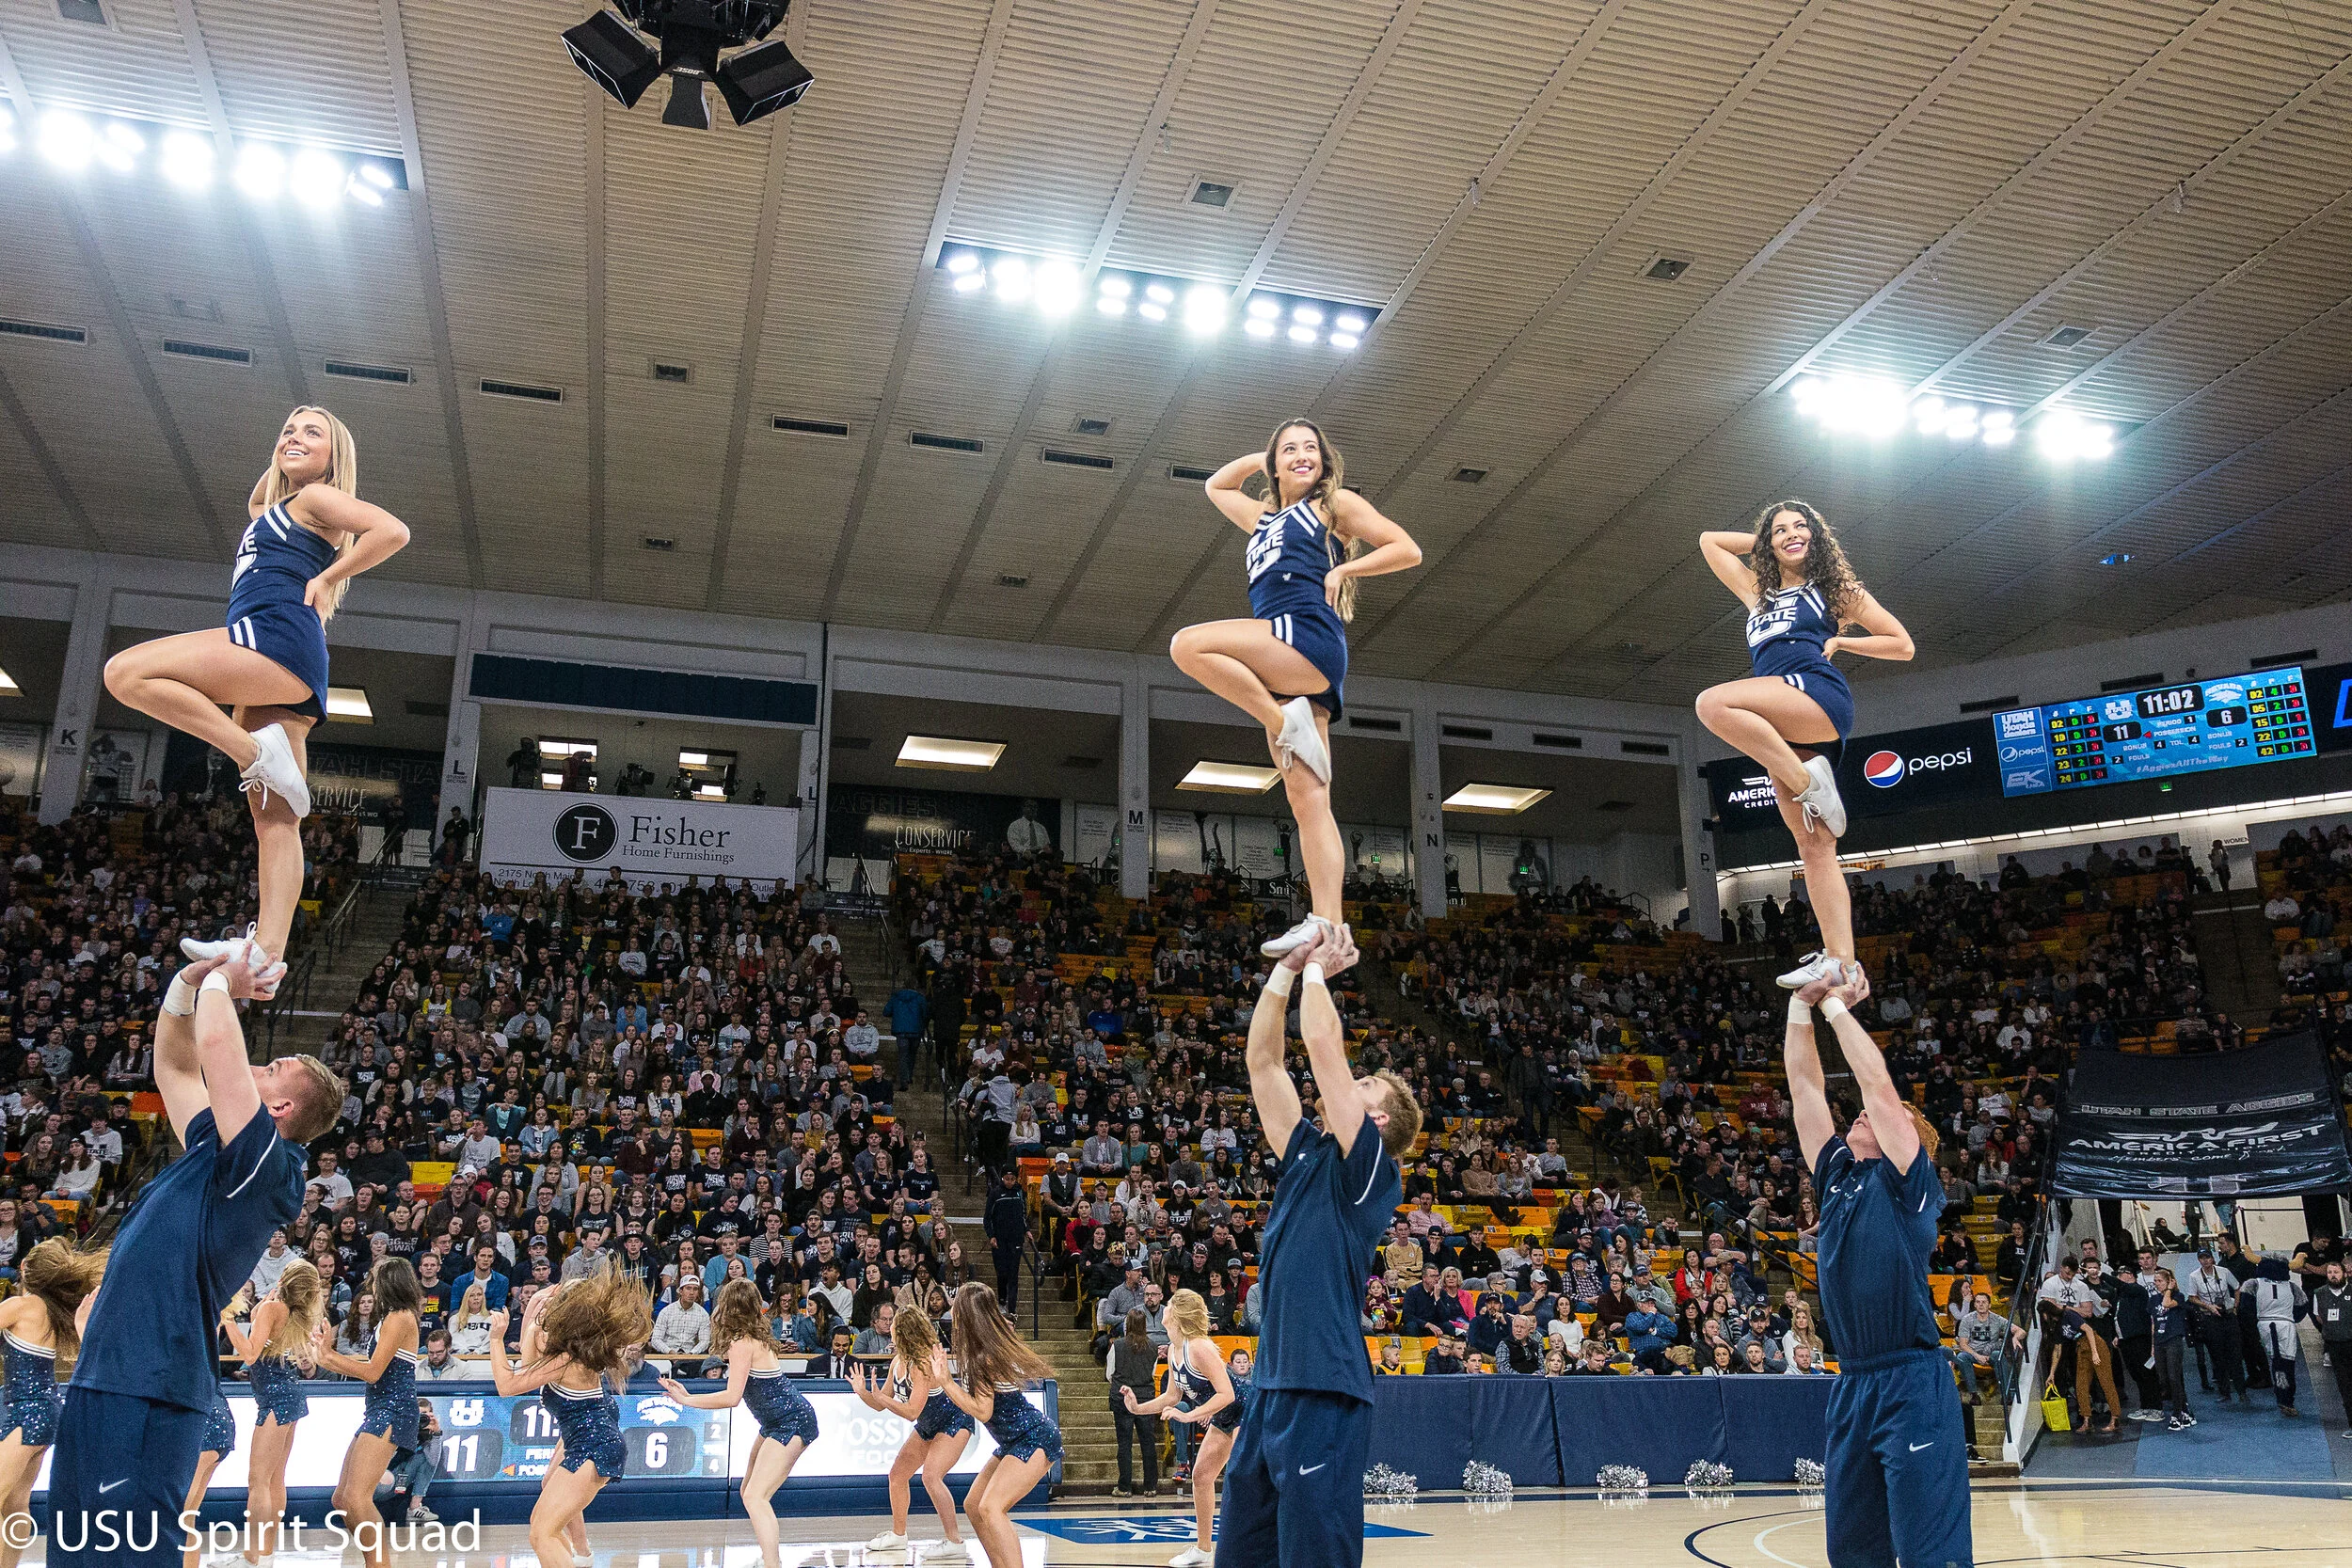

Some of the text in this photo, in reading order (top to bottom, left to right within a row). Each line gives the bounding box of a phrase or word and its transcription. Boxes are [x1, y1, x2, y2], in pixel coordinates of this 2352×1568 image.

[1747, 607, 1798, 632] STATE
[2143, 689, 2195, 715] 11:02
[2220, 710, 2233, 724] 6
[2255, 718, 2268, 727] 15
[61, 729, 77, 745] K
[2114, 725, 2129, 740] 11
[2258, 733, 2271, 742] 22
[2018, 745, 2044, 758] pepsi
[2056, 747, 2068, 756] 22
[2075, 745, 2083, 753] 3
[453, 760, 466, 775] L
[1908, 747, 1972, 776] pepsi
[2058, 761, 2070, 769] 23
[1727, 787, 1776, 803] AMERIC
[1129, 810, 1143, 824] M
[571, 816, 601, 849] F
[628, 815, 731, 848] Fisher
[1426, 833, 1438, 847] N
[622, 845, 735, 863] Home Furnishings
[1701, 853, 1709, 865] P
[499, 868, 522, 878] 2175
[2081, 1092, 2314, 1117] UTAH STATE AGGIES
[2069, 1138, 2219, 1153] AMERICA
[2227, 1124, 2325, 1148] FIRST
[2272, 1285, 2278, 1299] 1
[710, 1423, 722, 1439] 2
[443, 1435, 479, 1471] 11
[644, 1432, 669, 1468] 6
